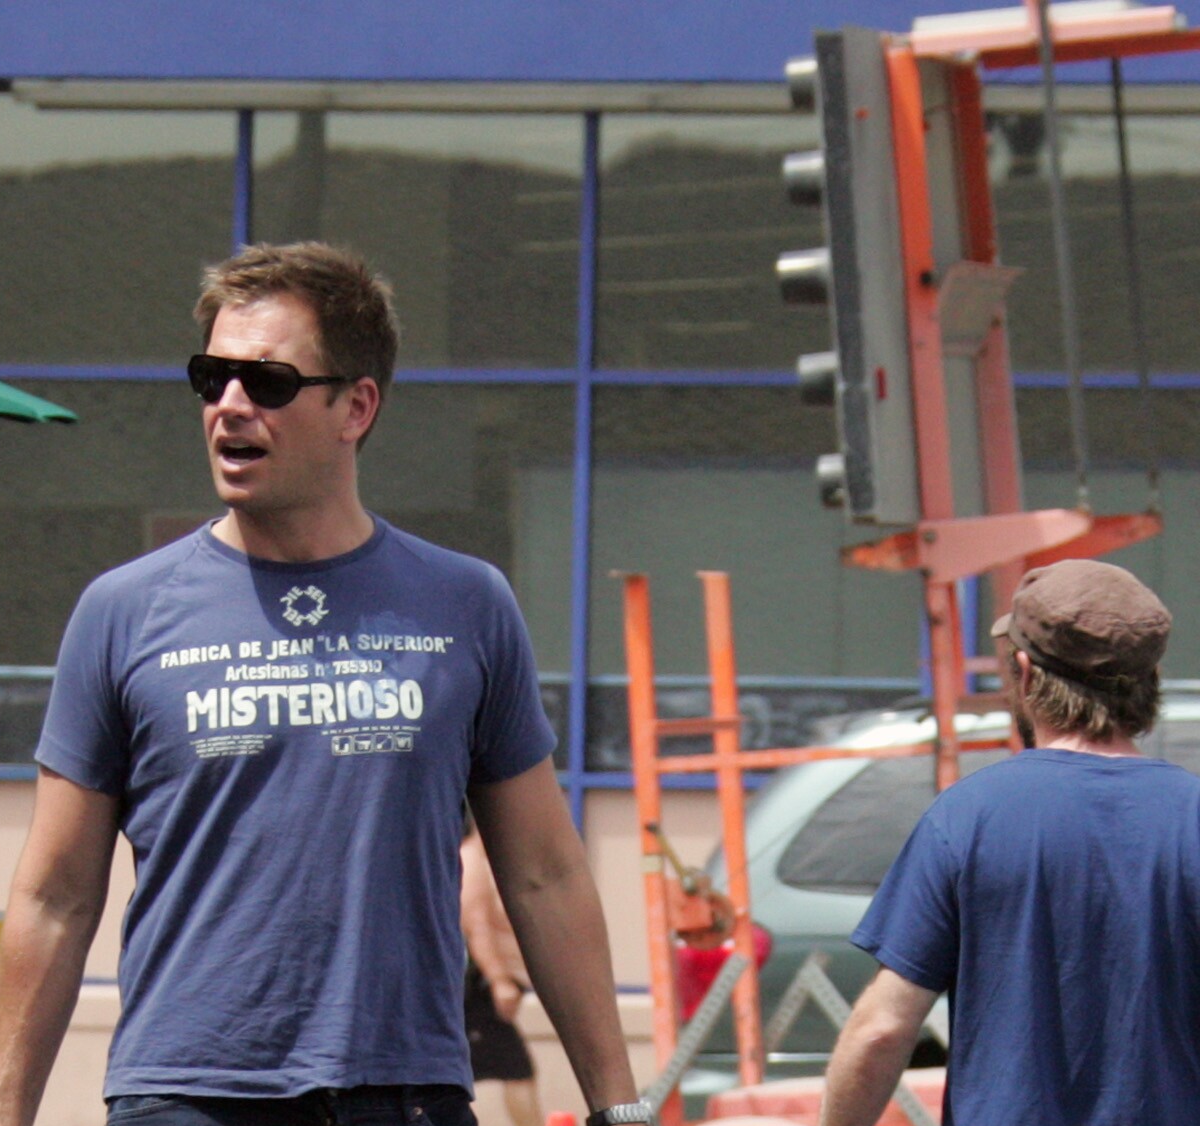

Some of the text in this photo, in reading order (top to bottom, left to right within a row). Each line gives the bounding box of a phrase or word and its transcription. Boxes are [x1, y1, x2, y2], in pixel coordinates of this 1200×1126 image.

[160, 643, 232, 669] FABRICA
[239, 641, 262, 659] DE
[266, 638, 314, 660] JEAN
[357, 634, 454, 653] SUPERIOR"
[225, 663, 309, 681] Artesianas
[186, 679, 424, 732] MISTERIOSO
